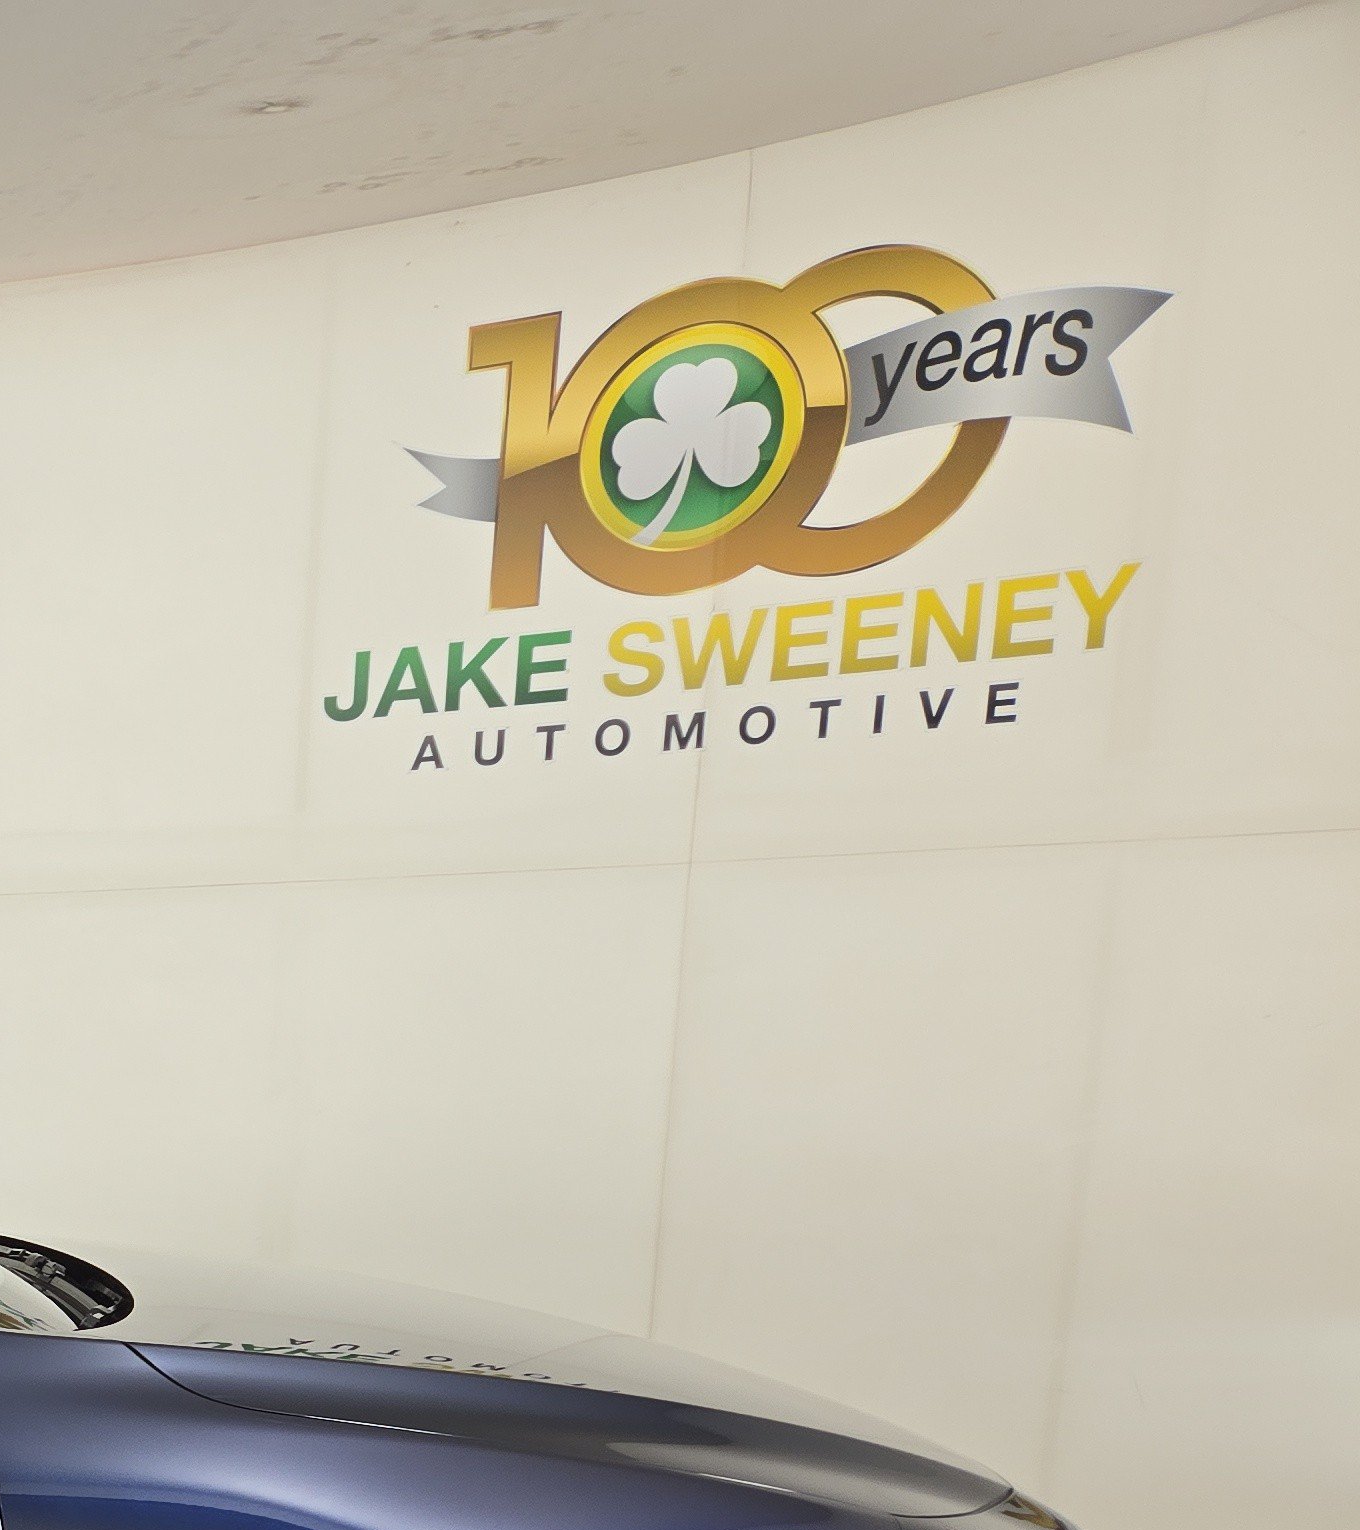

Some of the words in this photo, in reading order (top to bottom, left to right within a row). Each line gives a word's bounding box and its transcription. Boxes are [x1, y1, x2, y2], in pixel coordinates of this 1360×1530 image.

[467, 244, 1012, 611] 100
[863, 308, 1094, 427] years
[323, 630, 572, 722] JAKE
[602, 562, 1142, 698] SWEENEY
[410, 682, 1020, 771] AUTOMOTIVE
